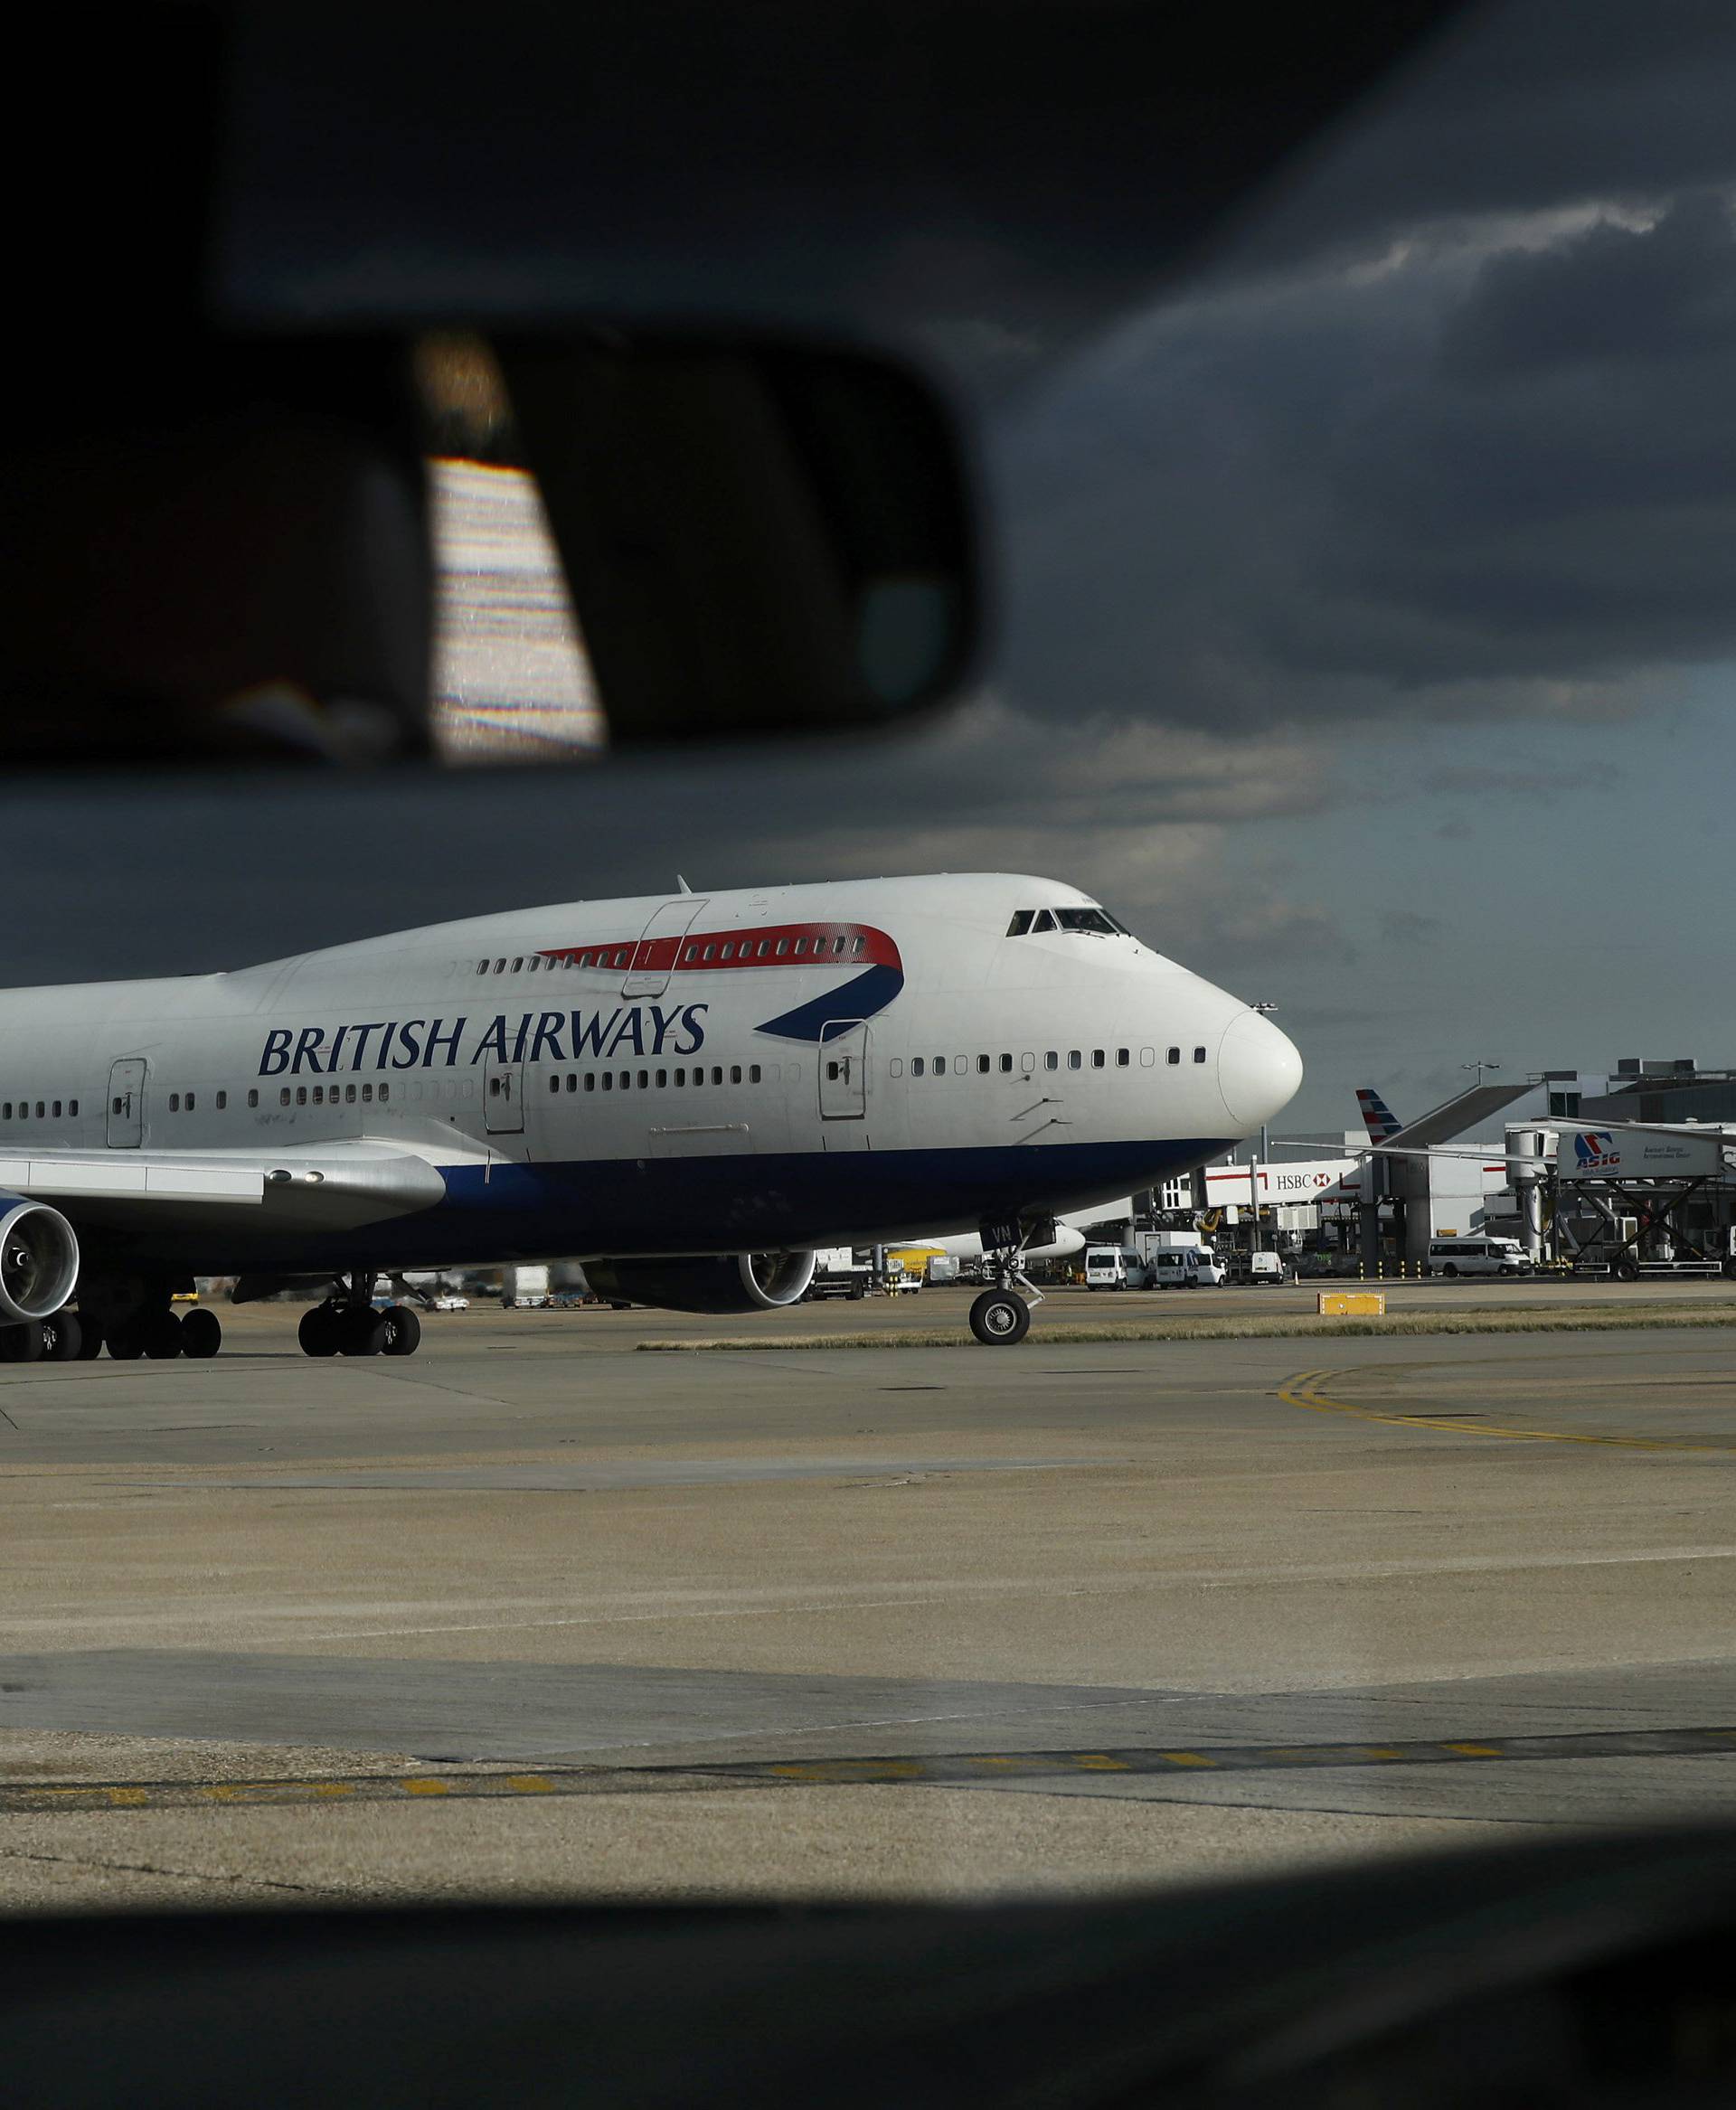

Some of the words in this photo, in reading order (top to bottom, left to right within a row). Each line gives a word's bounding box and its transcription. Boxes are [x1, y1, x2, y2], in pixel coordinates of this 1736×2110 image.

[259, 1017, 467, 1076] BRITISH
[470, 1003, 709, 1065] AIRWAYS
[1577, 1152, 1620, 1168] ASIG
[1277, 1173, 1310, 1190] HSBC
[993, 1225, 1013, 1243] VN
